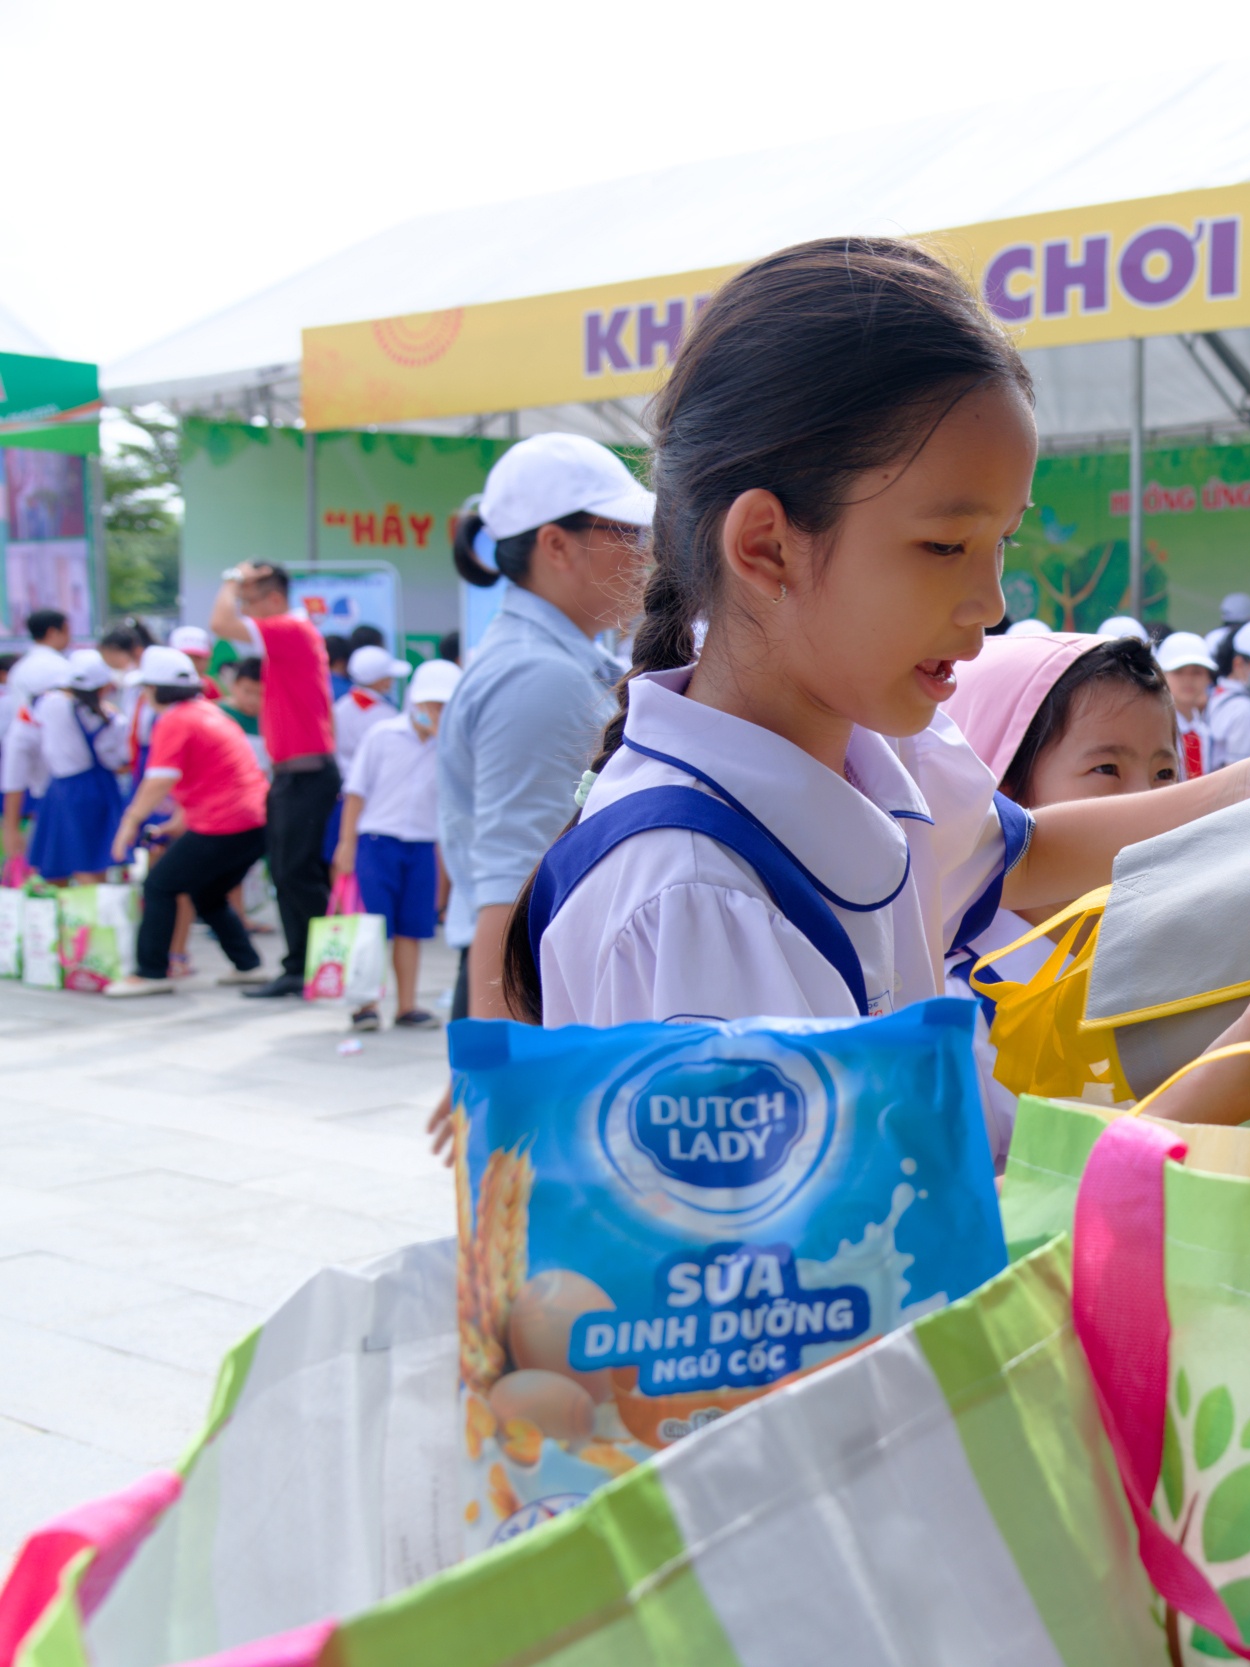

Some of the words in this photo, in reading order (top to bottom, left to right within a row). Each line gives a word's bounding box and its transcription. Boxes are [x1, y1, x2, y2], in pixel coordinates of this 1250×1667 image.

[584, 295, 712, 374] KH
[984, 219, 1238, 321] CHƠI
[650, 1091, 786, 1129] DUTCH
[667, 1125, 774, 1164] LADY
[667, 1253, 785, 1308] SỮA
[584, 1314, 699, 1358] DINH
[708, 1297, 854, 1345] DƯỠNG
[651, 1348, 721, 1384] NGŨ
[727, 1339, 787, 1376] CỐC
